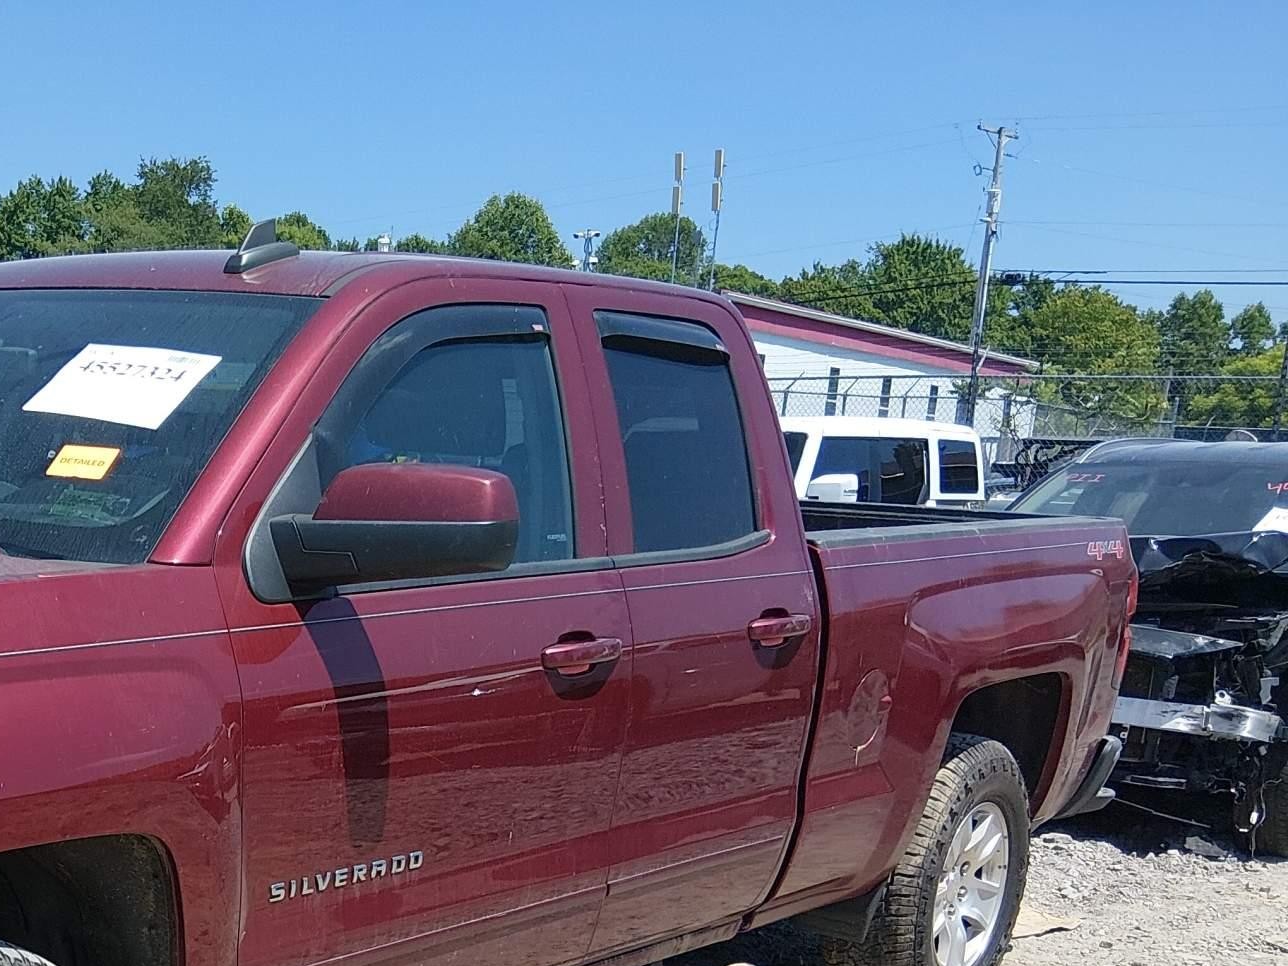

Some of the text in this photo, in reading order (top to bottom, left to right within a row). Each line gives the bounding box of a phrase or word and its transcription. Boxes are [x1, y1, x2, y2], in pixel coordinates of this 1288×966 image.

[80, 360, 187, 381] 45527324
[59, 456, 105, 468] DETAILED
[269, 851, 423, 903] SILVERADO
